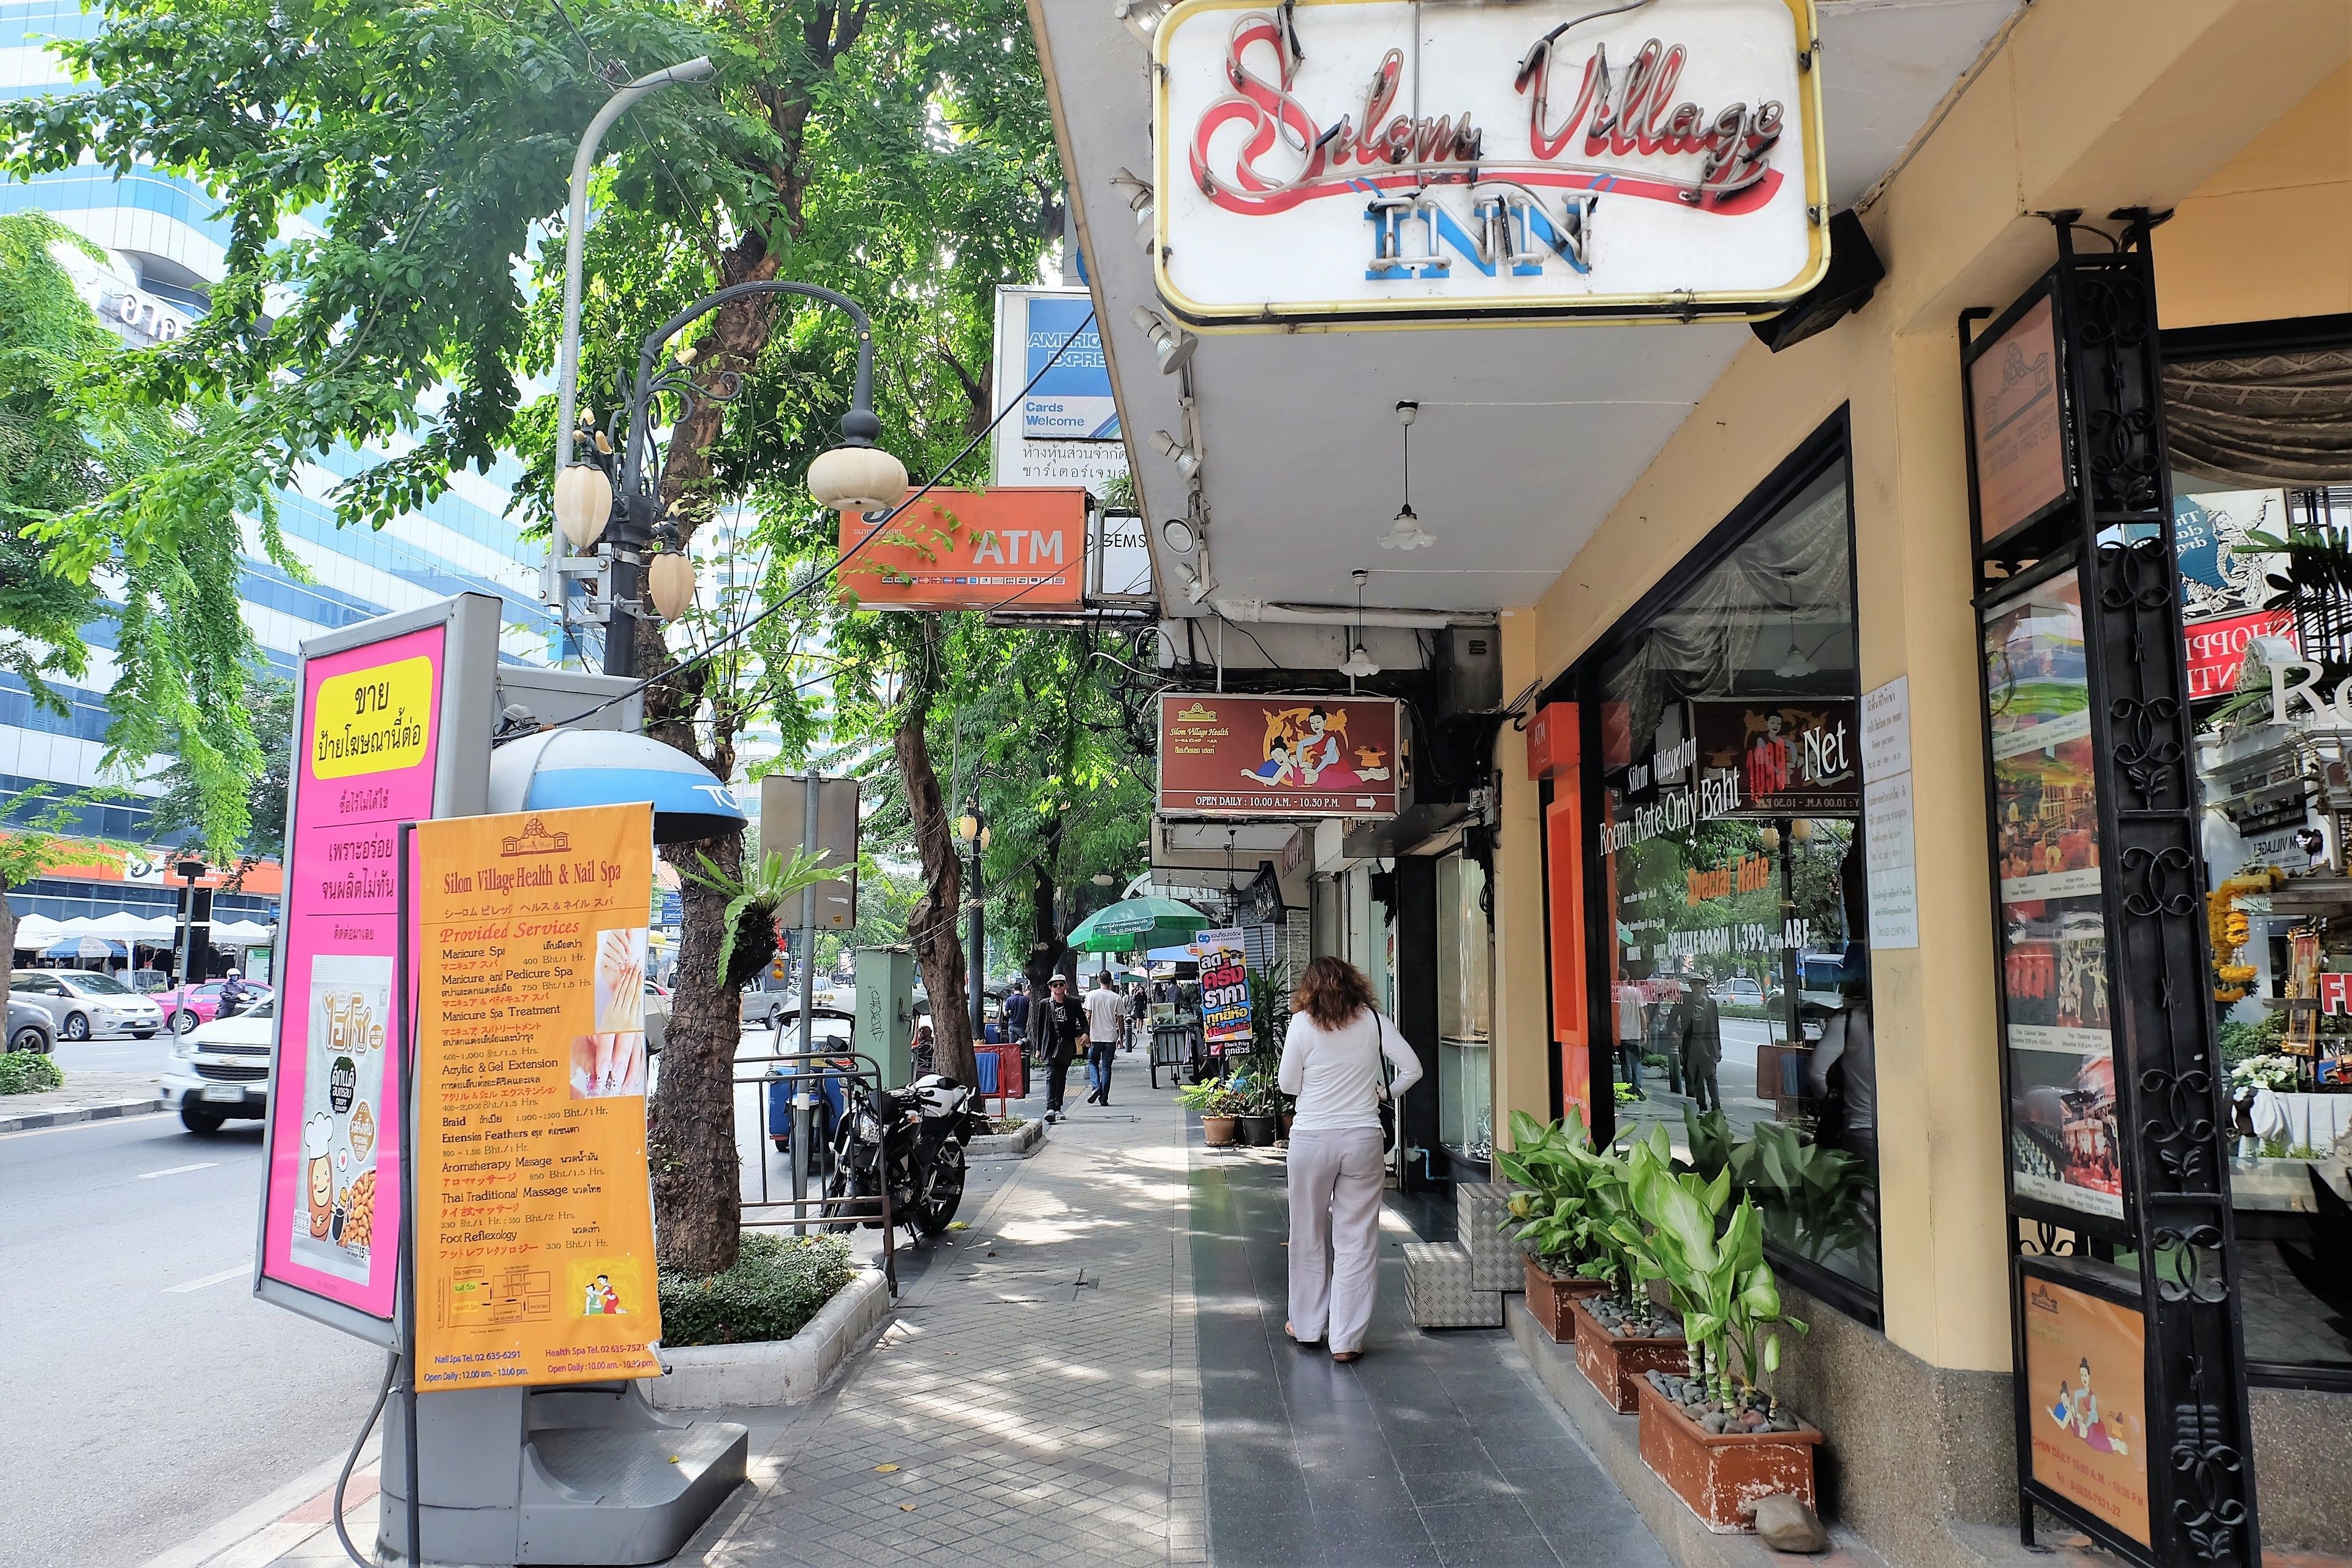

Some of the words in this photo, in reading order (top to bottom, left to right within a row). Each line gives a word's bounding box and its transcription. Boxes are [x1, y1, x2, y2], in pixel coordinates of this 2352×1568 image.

[1190, 11, 1482, 214] Silom
[1515, 37, 1784, 191] Village
[1363, 188, 1597, 280] INN
[1026, 401, 1063, 412] Cards
[1026, 415, 1084, 426] Welcome
[1023, 443, 1127, 464] ห้างหุ้นส่วนจำกัด
[973, 530, 1063, 565] ATM
[1103, 533, 1146, 548] GEMS
[355, 681, 390, 715] ขาย
[318, 706, 421, 761] ป้ายโฆษณานี้ต่อ
[1169, 727, 1186, 736] Silom
[1187, 728, 1207, 737] Village
[1534, 720, 1546, 747] ATM
[1627, 764, 1648, 795] Silom
[1653, 745, 1682, 783] Village
[1681, 736, 1697, 770] Inn
[1599, 818, 1631, 856] Room
[1635, 803, 1663, 843] Rate
[1665, 784, 1698, 835] Only
[1700, 765, 1742, 821] Baht
[1802, 719, 1849, 782] Net
[1195, 796, 1218, 807] OPEN
[1219, 796, 1243, 807] DAILY
[1250, 796, 1273, 807] 10.00
[1274, 797, 1292, 807] A.M.
[1300, 797, 1322, 808] 10.30
[1324, 798, 1340, 808] P.M.
[329, 832, 393, 861] เพราะอร่อย
[322, 868, 394, 899] จนผลิตไม่ทัน
[444, 872, 472, 895] Silom
[478, 867, 514, 895] Village
[516, 864, 553, 888] Health
[559, 864, 568, 884] &
[574, 859, 595, 883] Nail
[600, 860, 621, 888] Spa
[1687, 862, 1732, 908] Special
[1737, 850, 1770, 893] Rate
[445, 907, 478, 919] シーロム
[520, 901, 550, 912] ヘルス
[564, 899, 590, 910] ネイル
[334, 924, 374, 940] ติดต่อมาเลย
[440, 922, 508, 943] Provided
[513, 920, 580, 940] Services
[543, 939, 582, 951] เล็บมือสปา
[1700, 926, 1730, 954] ROOM
[442, 948, 484, 959] Manicure
[489, 946, 506, 959] Spa
[571, 953, 586, 962] Hr.
[1201, 952, 1221, 968] ลด
[440, 960, 477, 971] マニキュア
[442, 973, 484, 986] Manicure
[489, 971, 503, 982] and
[506, 968, 551, 981] Pedicure
[554, 966, 573, 978] Spa
[522, 983, 537, 992] 750
[1204, 984, 1246, 1008] ราคา
[442, 1011, 486, 1022] Manicure
[490, 1009, 503, 1020] Spa
[508, 1005, 561, 1017] Treatment
[1206, 1005, 1248, 1027] ทุกยี่ห้อ
[442, 1063, 474, 1076] Acrylic
[479, 1062, 486, 1073] &
[488, 1061, 503, 1072] Gel
[508, 1058, 559, 1071] Extension
[595, 1106, 608, 1115] Hr.
[442, 1117, 466, 1127] Braid
[442, 1133, 481, 1144] Extension
[484, 1129, 528, 1140] Feathers
[442, 1159, 511, 1173] Aromatherapy
[515, 1156, 552, 1168] Massage
[560, 1150, 598, 1164] นวดน้ำมัน
[442, 1192, 464, 1204] Thai
[467, 1188, 518, 1202] Traditional
[522, 1185, 568, 1197] Massage
[572, 1185, 601, 1195] นวดไทย
[559, 1211, 575, 1219] Hrs.
[572, 1221, 600, 1235] นวดเท้า
[440, 1234, 462, 1245] Foot
[464, 1230, 518, 1243] Reflexology
[546, 1242, 561, 1251] 330
[596, 1238, 608, 1247] Hr.
[450, 1355, 461, 1364] Spa
[486, 1350, 521, 1360] 635-6291
[546, 1348, 570, 1357] Health
[572, 1347, 586, 1357] Spa
[587, 1346, 599, 1355] Tel.
[548, 1364, 566, 1374] Open
[568, 1363, 583, 1373] Daily
[641, 1360, 655, 1368] pm.
[424, 1373, 442, 1382] Open
[443, 1372, 458, 1382] Daily
[462, 1371, 479, 1379] 12.00
[2032, 1435, 2051, 1455] OPEN
[2052, 1447, 2071, 1468] DAILY
[2056, 1471, 2065, 1485] Tel
